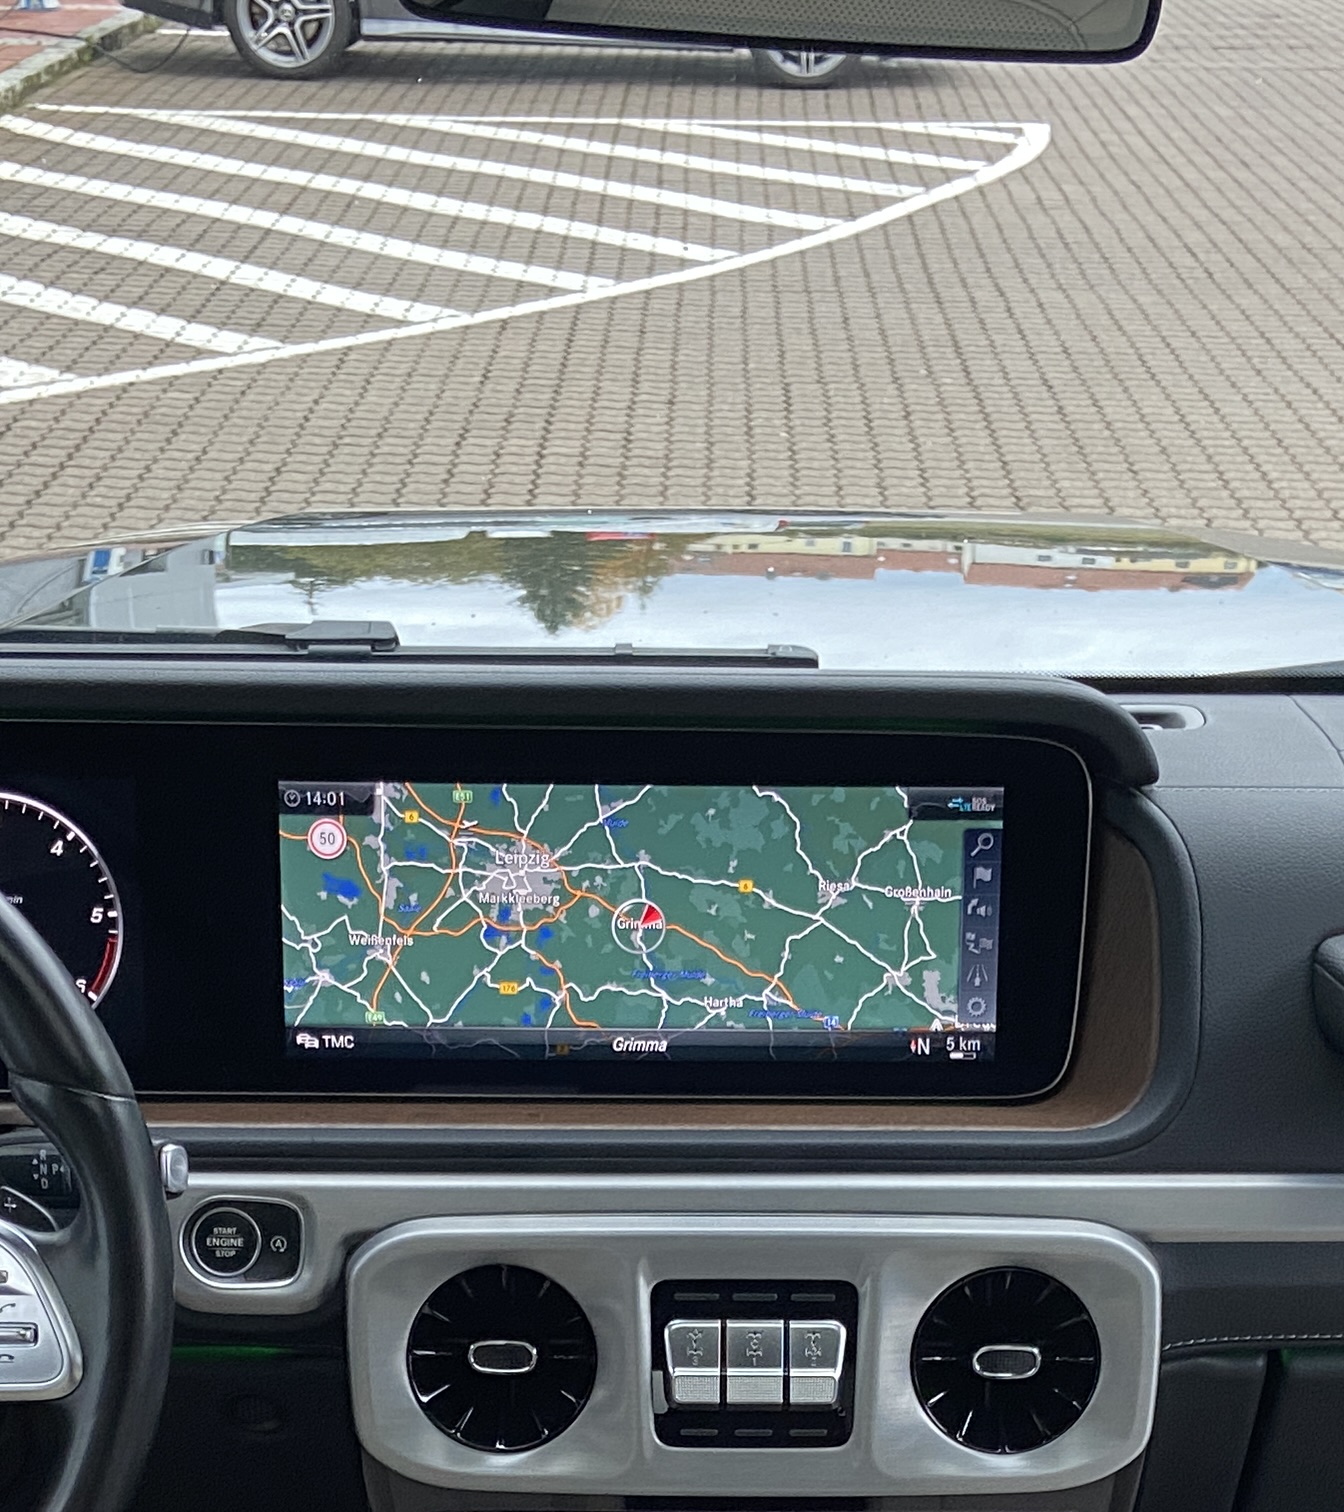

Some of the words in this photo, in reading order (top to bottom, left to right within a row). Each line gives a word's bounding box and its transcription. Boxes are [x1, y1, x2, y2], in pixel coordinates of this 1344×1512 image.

[306, 792, 346, 806] 14:01
[319, 832, 337, 846] 50
[50, 840, 65, 857] 4
[494, 850, 550, 867] Leipzig
[818, 880, 851, 892] Riesa
[885, 886, 953, 899] Großenhain
[89, 907, 104, 923] 5
[501, 984, 517, 993] 176
[704, 996, 744, 1009] Hartha
[322, 1035, 355, 1048] TMC
[612, 1037, 668, 1052] Grimma
[917, 1037, 930, 1055] N
[946, 1036, 955, 1051] 5
[959, 1036, 981, 1051] km
[213, 1227, 237, 1235] START
[206, 1237, 244, 1247] ENGINE
